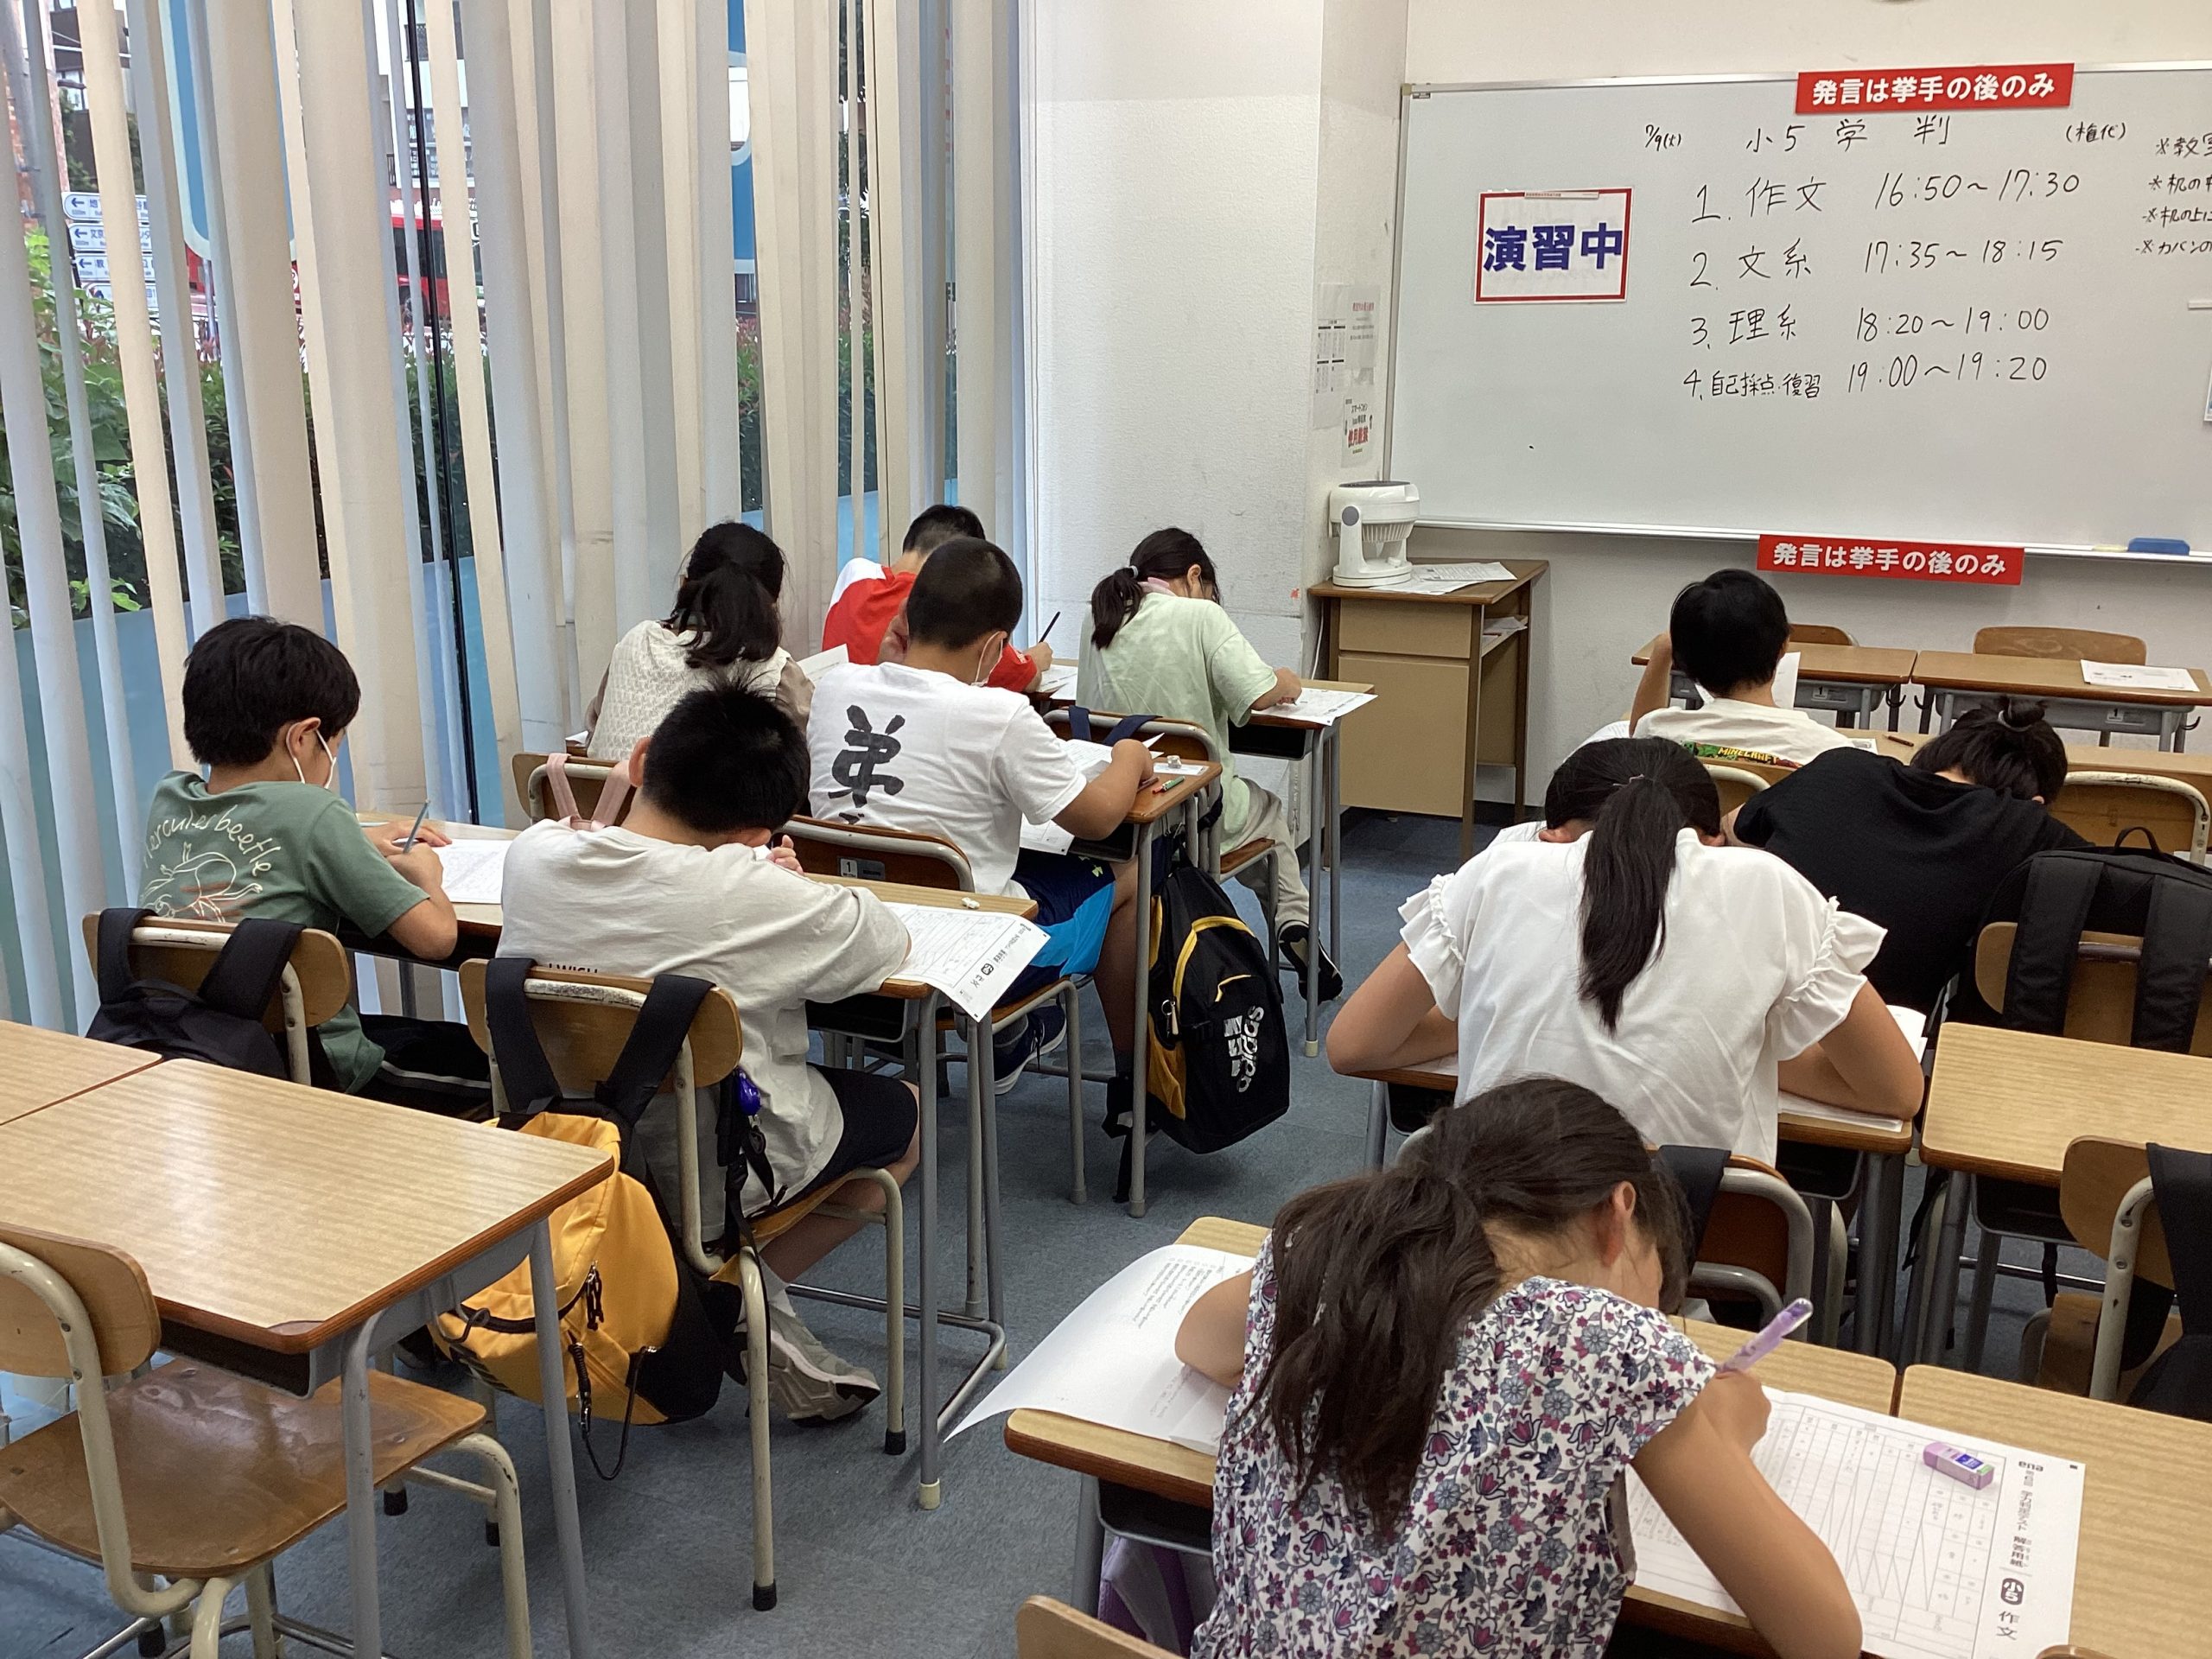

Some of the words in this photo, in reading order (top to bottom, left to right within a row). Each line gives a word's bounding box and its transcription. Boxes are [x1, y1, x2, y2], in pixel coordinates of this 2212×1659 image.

[1812, 73, 2056, 105] 発言は挙手の後のみ
[1745, 175, 1827, 217] 作文
[1483, 222, 1624, 272] 演習中
[1738, 237, 1811, 280] 文系
[1728, 303, 1797, 345] 理系
[1772, 542, 2007, 576] 発言は挙手の後のみ
[1717, 747, 1779, 765] MINECRAFT
[2018, 1460, 2044, 1472] ena
[1996, 1610, 2020, 1641] 作文
